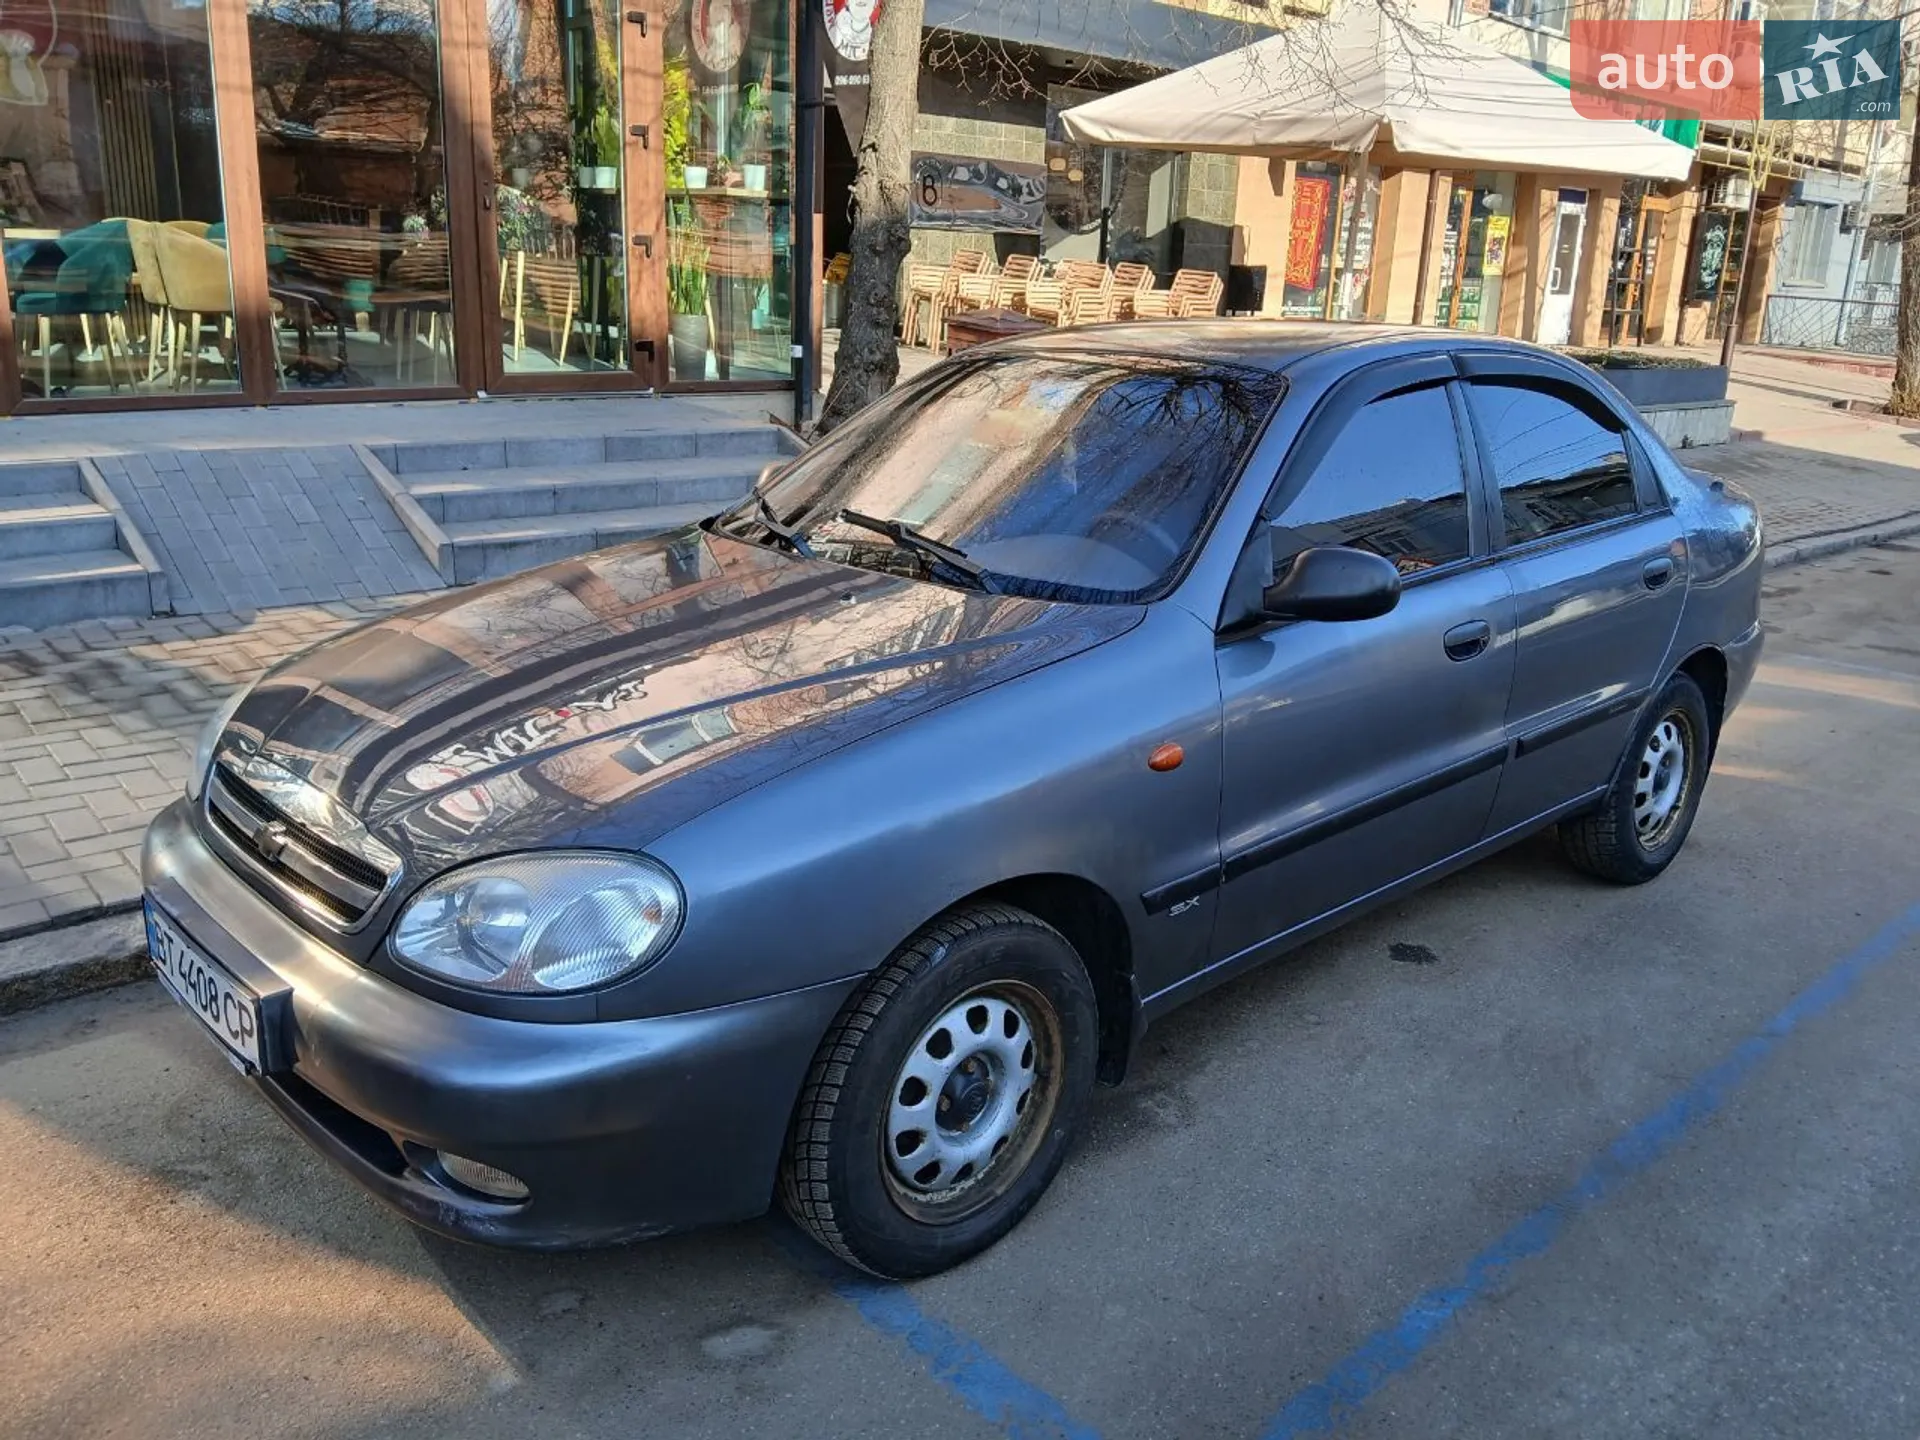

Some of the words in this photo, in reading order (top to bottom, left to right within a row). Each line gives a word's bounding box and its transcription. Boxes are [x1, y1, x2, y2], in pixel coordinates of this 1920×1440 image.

[1168, 895, 1200, 917] SX
[178, 950, 221, 1024] 4408
[223, 991, 254, 1047] CP
